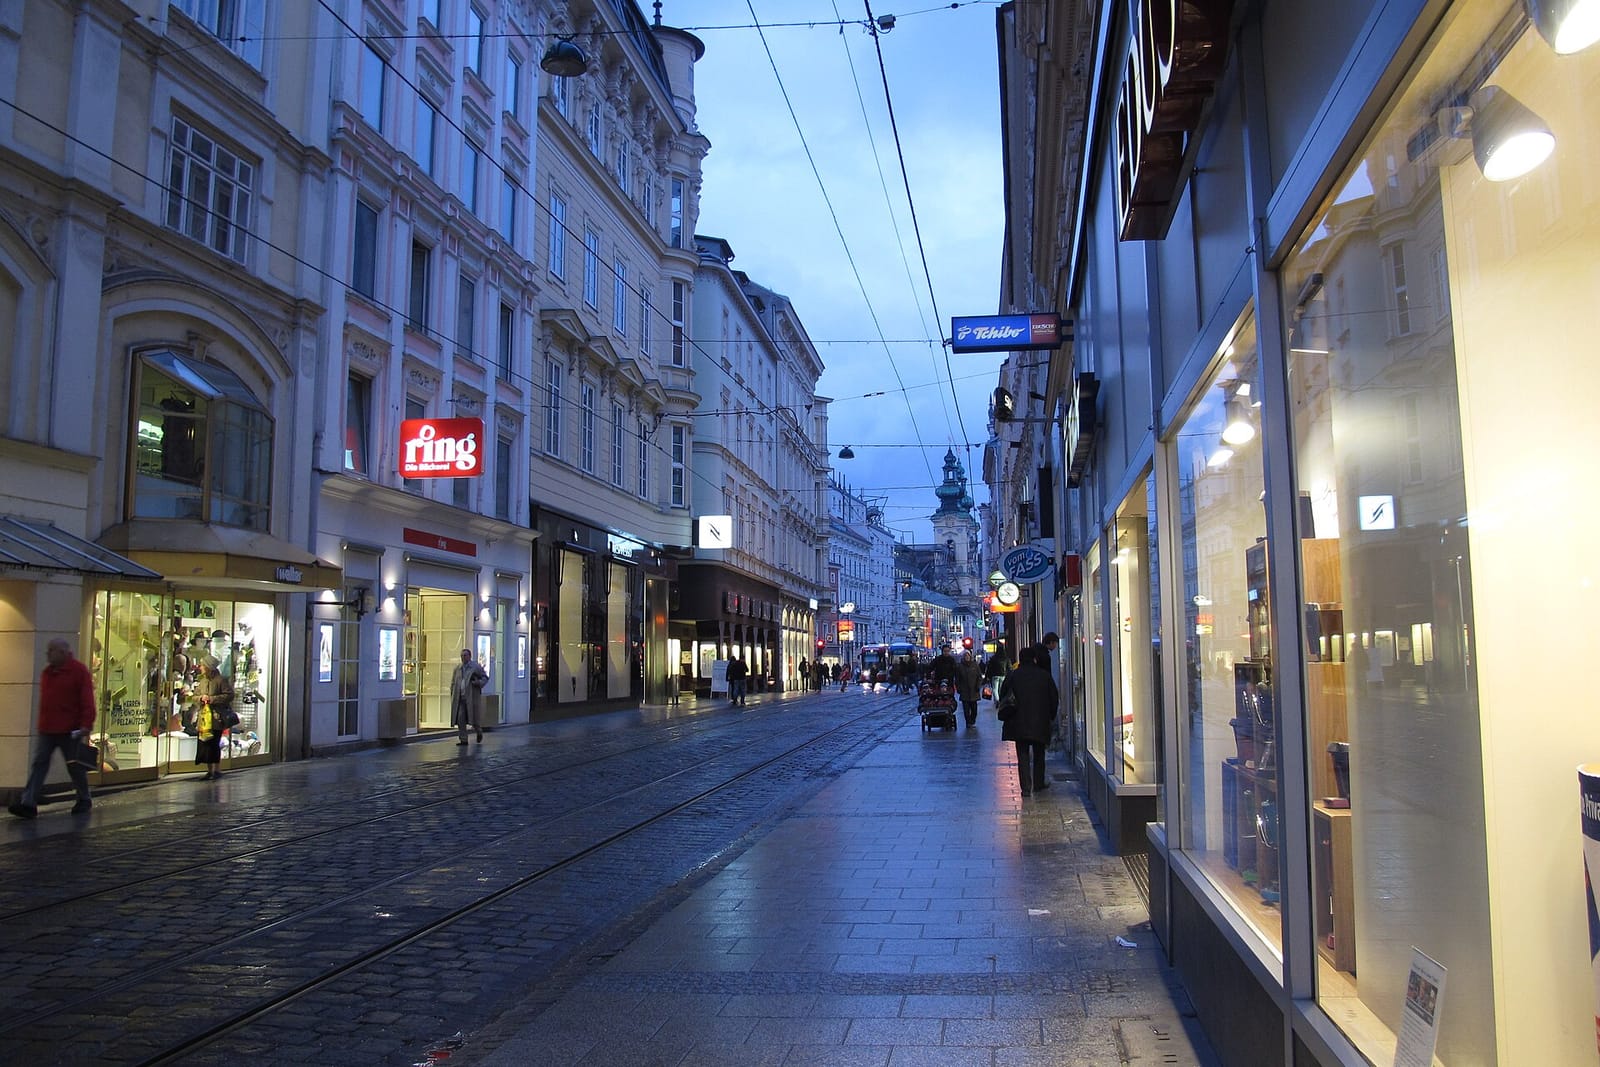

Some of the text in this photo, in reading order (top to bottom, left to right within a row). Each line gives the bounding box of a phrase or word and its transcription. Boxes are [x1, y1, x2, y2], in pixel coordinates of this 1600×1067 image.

[972, 325, 1026, 340] Tchibo
[405, 424, 476, 471] ring
[1007, 551, 1026, 566] vom
[1008, 552, 1042, 580] FASS
